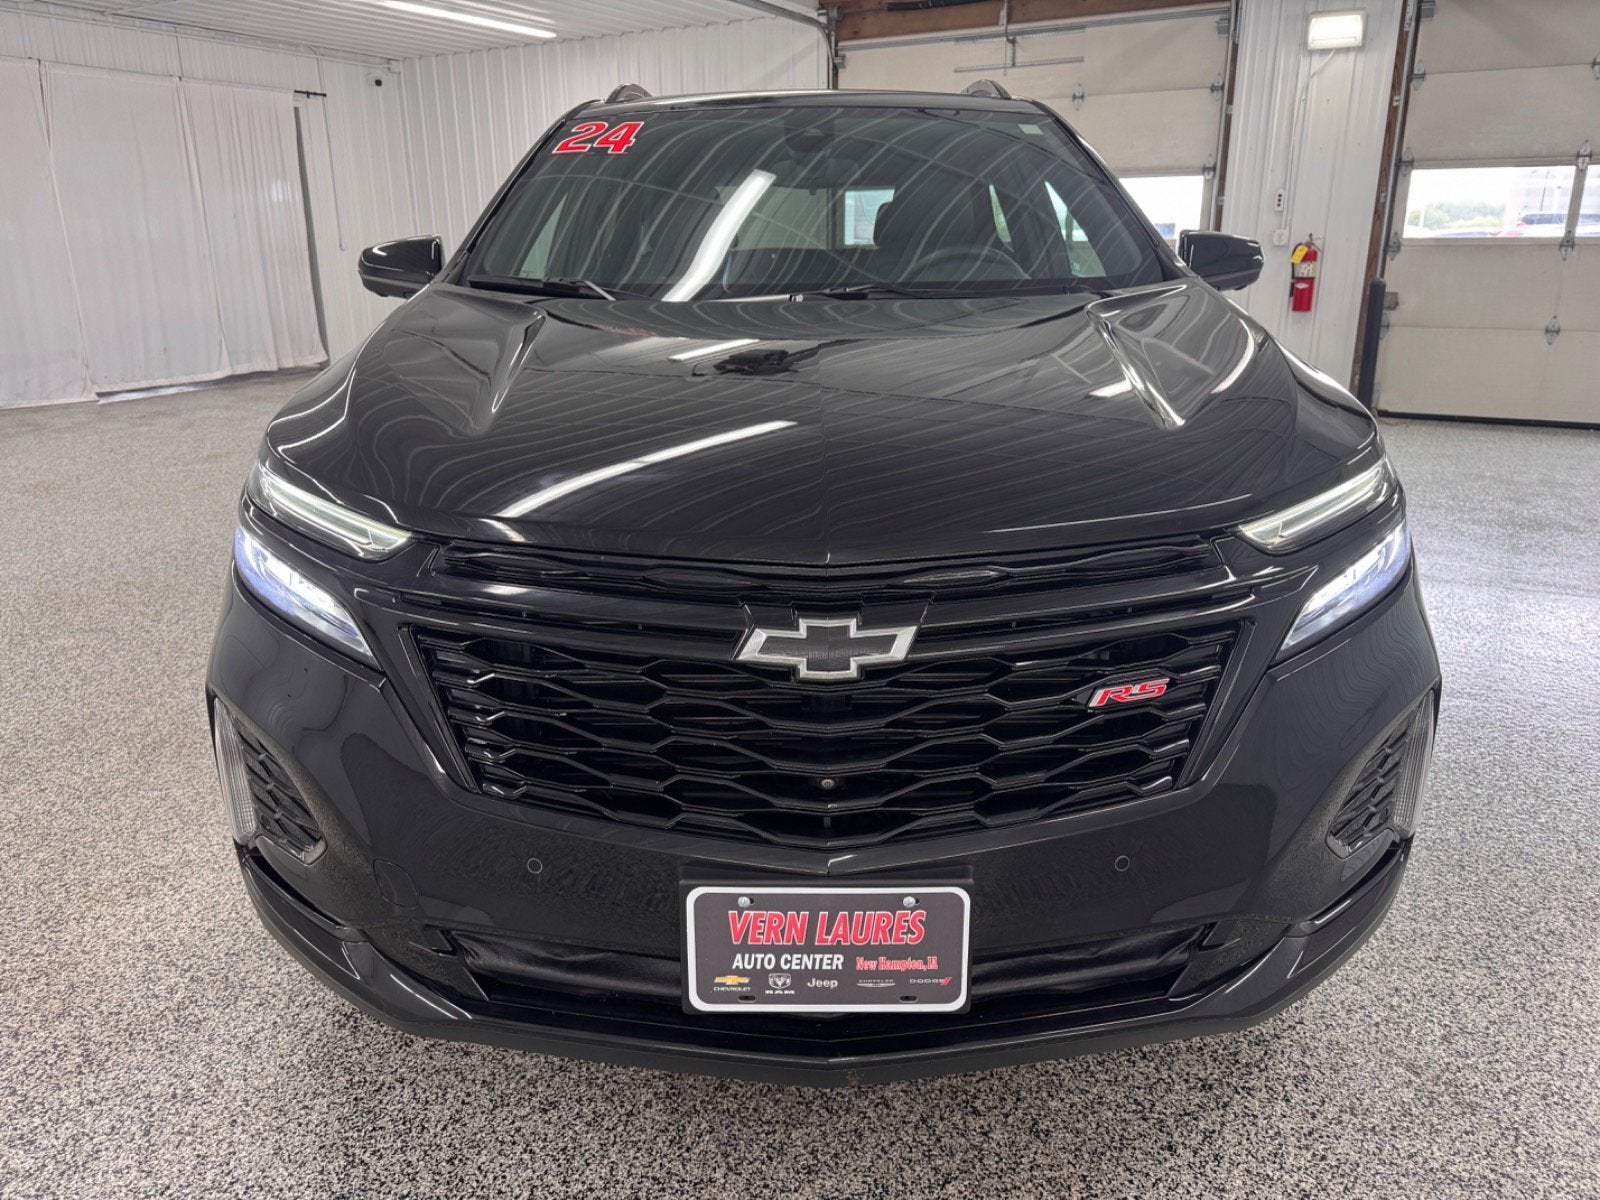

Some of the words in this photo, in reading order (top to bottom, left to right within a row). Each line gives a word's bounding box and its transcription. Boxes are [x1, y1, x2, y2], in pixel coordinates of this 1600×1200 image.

[552, 121, 645, 154] 24
[1089, 678, 1170, 707] RS
[728, 910, 809, 945] VERN
[815, 910, 927, 945] LAURES
[732, 953, 776, 970] AUTO
[780, 953, 844, 970] CENTER
[856, 957, 878, 970] New
[807, 977, 839, 989] Jeep
